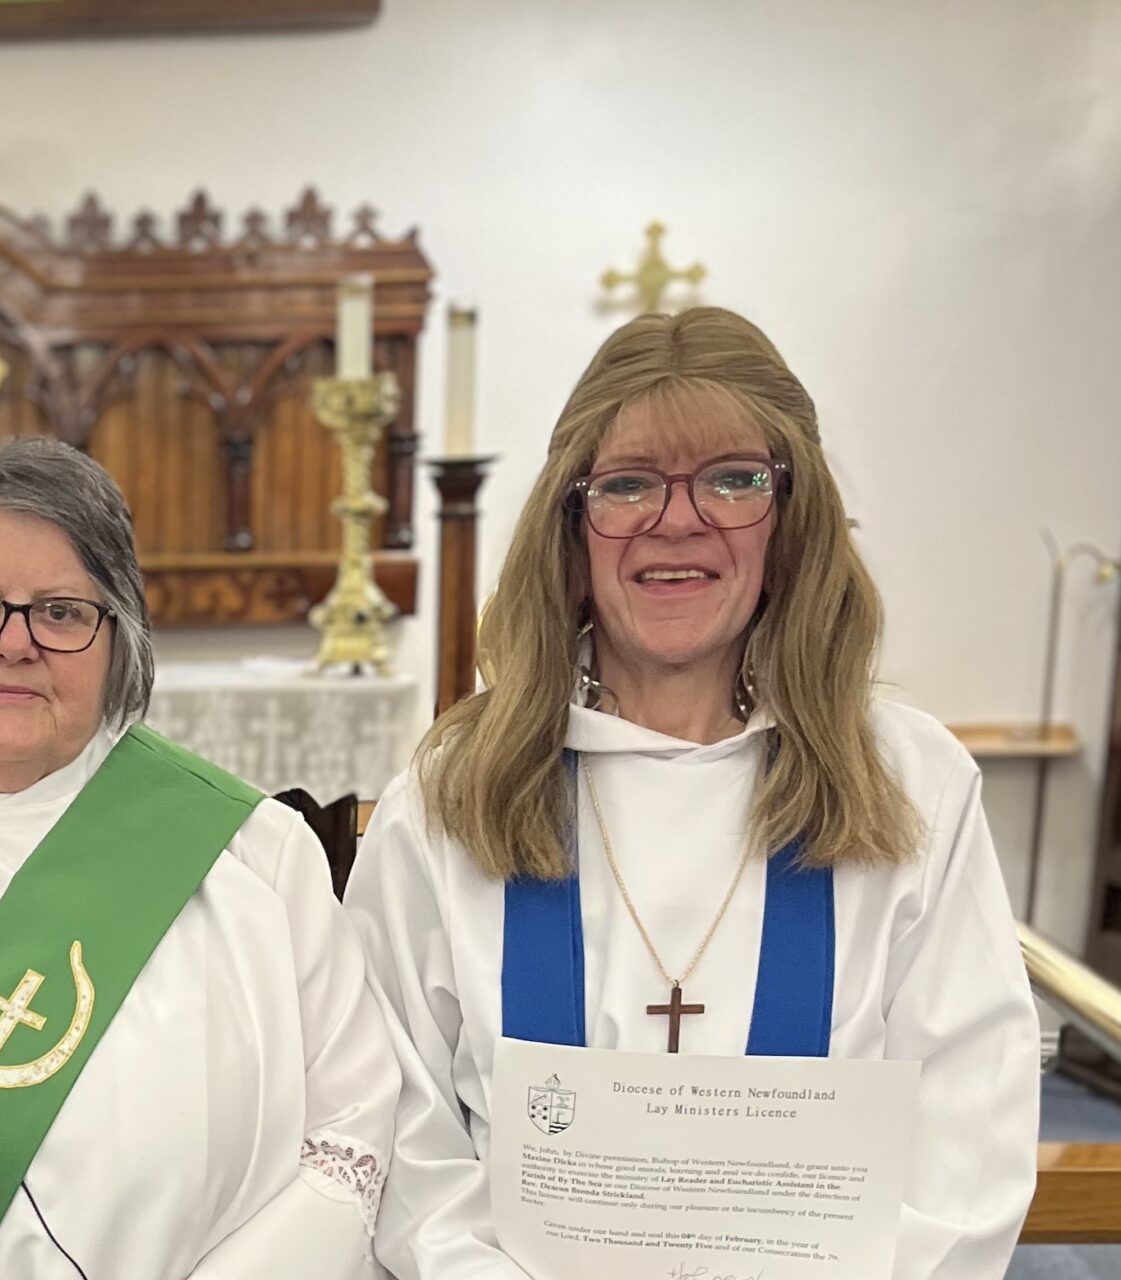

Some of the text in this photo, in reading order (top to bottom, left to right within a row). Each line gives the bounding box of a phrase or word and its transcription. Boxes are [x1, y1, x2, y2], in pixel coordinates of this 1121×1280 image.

[613, 1082, 836, 1100] Diocese of Western Newfoundland
[646, 1103, 797, 1118] Lay Ministers Licence
[522, 1153, 551, 1162] Maxine
[554, 1158, 577, 1166] Dicks
[522, 1170, 546, 1180] Parish
[558, 1176, 568, 1185] By
[570, 1178, 586, 1186] The
[661, 1176, 676, 1184] Lay
[678, 1176, 707, 1184] Reader
[727, 1178, 773, 1186] Eucharistic
[540, 1182, 569, 1192] Deacon
[571, 1187, 600, 1196] Brenda
[602, 1191, 646, 1199] Strickland.
[603, 1238, 643, 1246] Thousand
[663, 1241, 693, 1249] Twenty
[725, 1234, 764, 1245] February,
